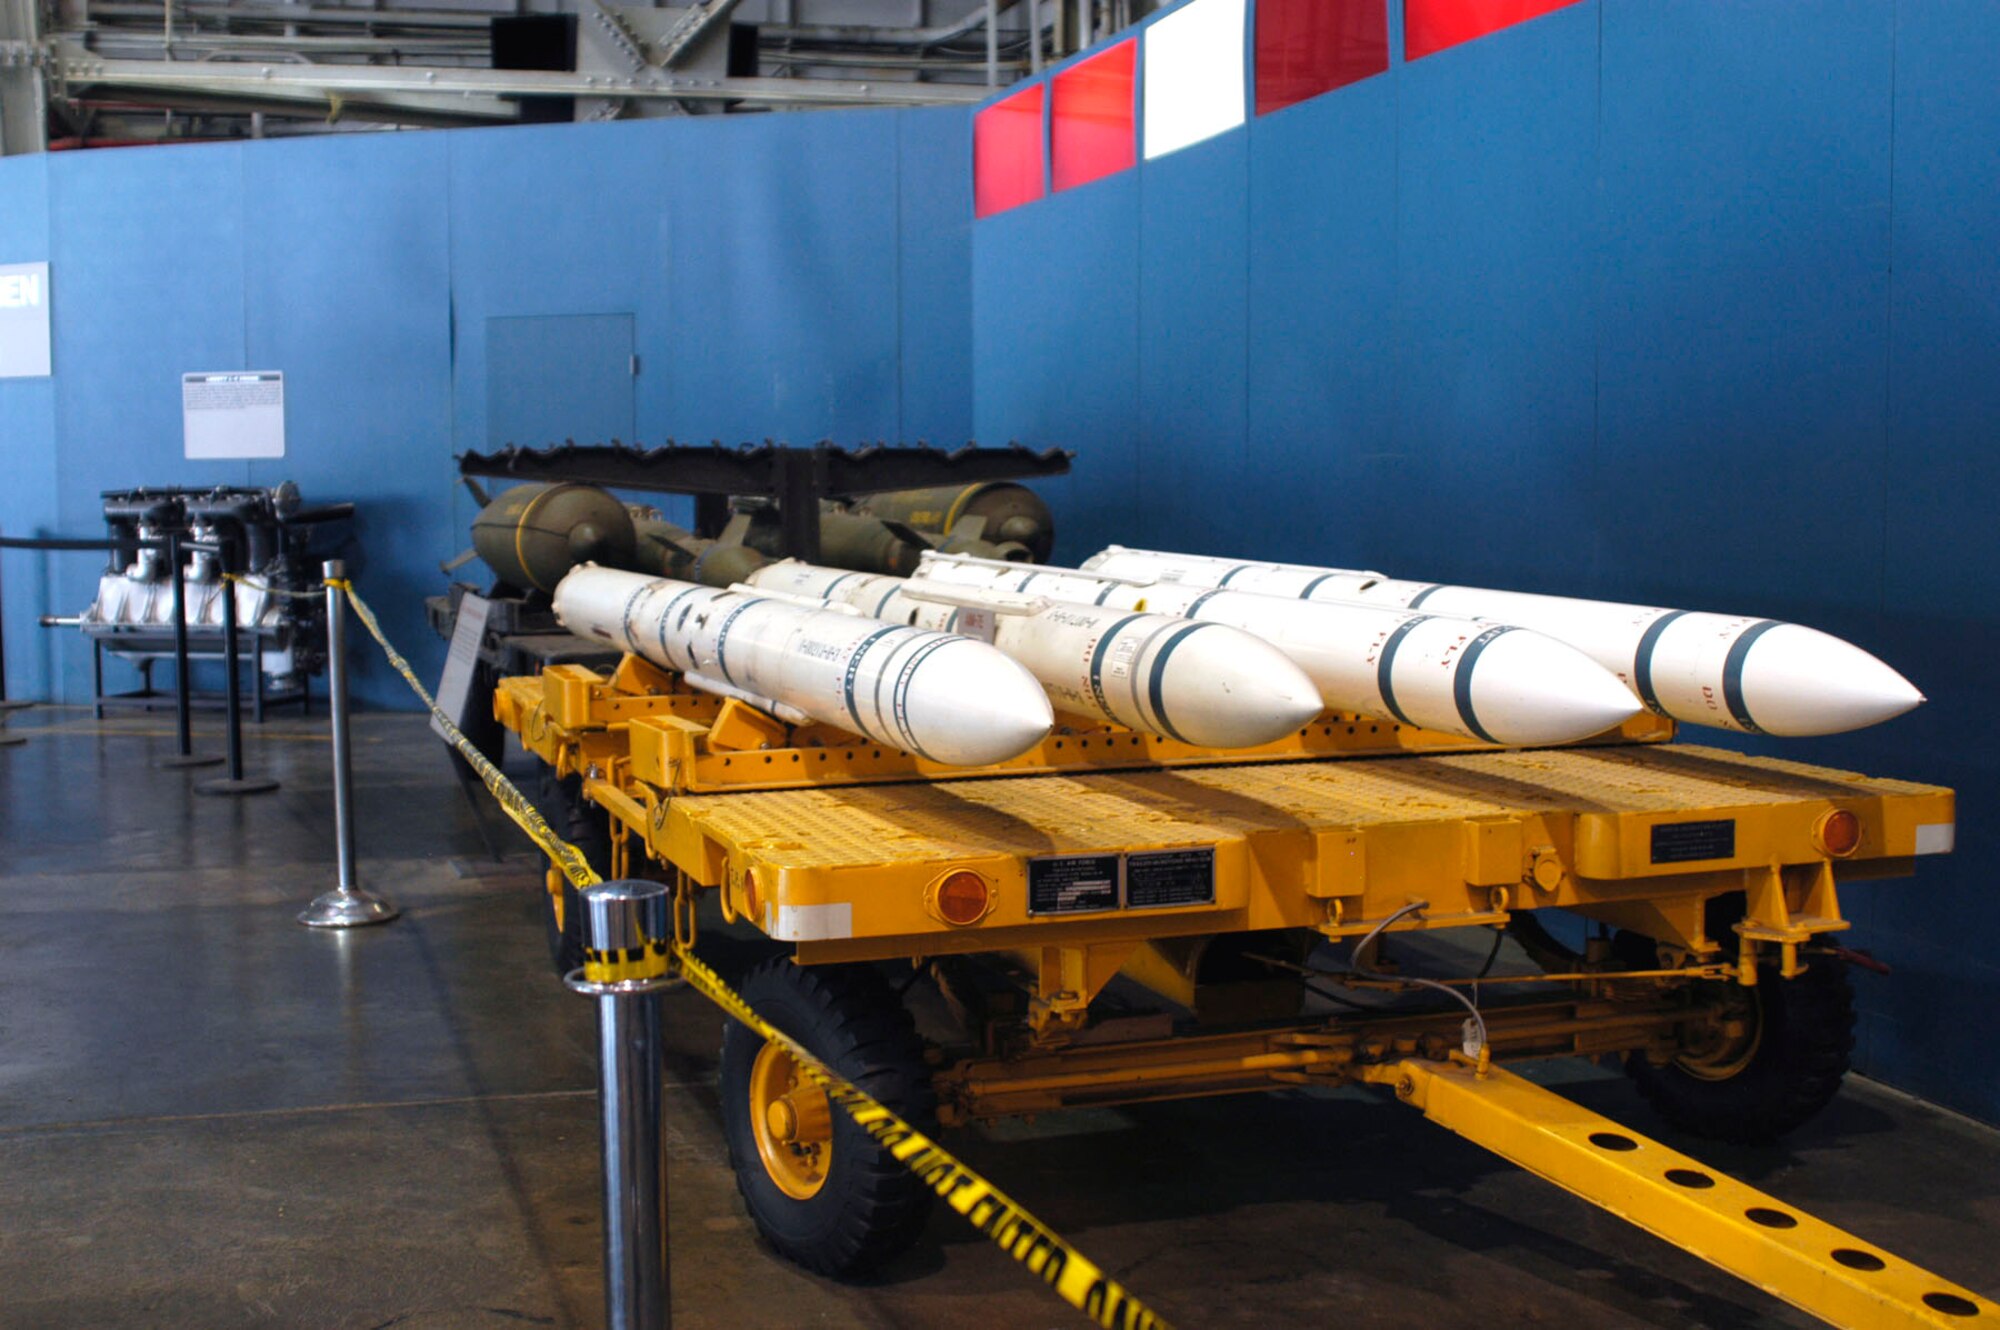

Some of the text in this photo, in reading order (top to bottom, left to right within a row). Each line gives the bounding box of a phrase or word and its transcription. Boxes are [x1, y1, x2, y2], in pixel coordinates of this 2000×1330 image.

[0, 272, 40, 309] EN
[845, 636, 877, 693] INERT
[1440, 635, 1467, 670] FLY
